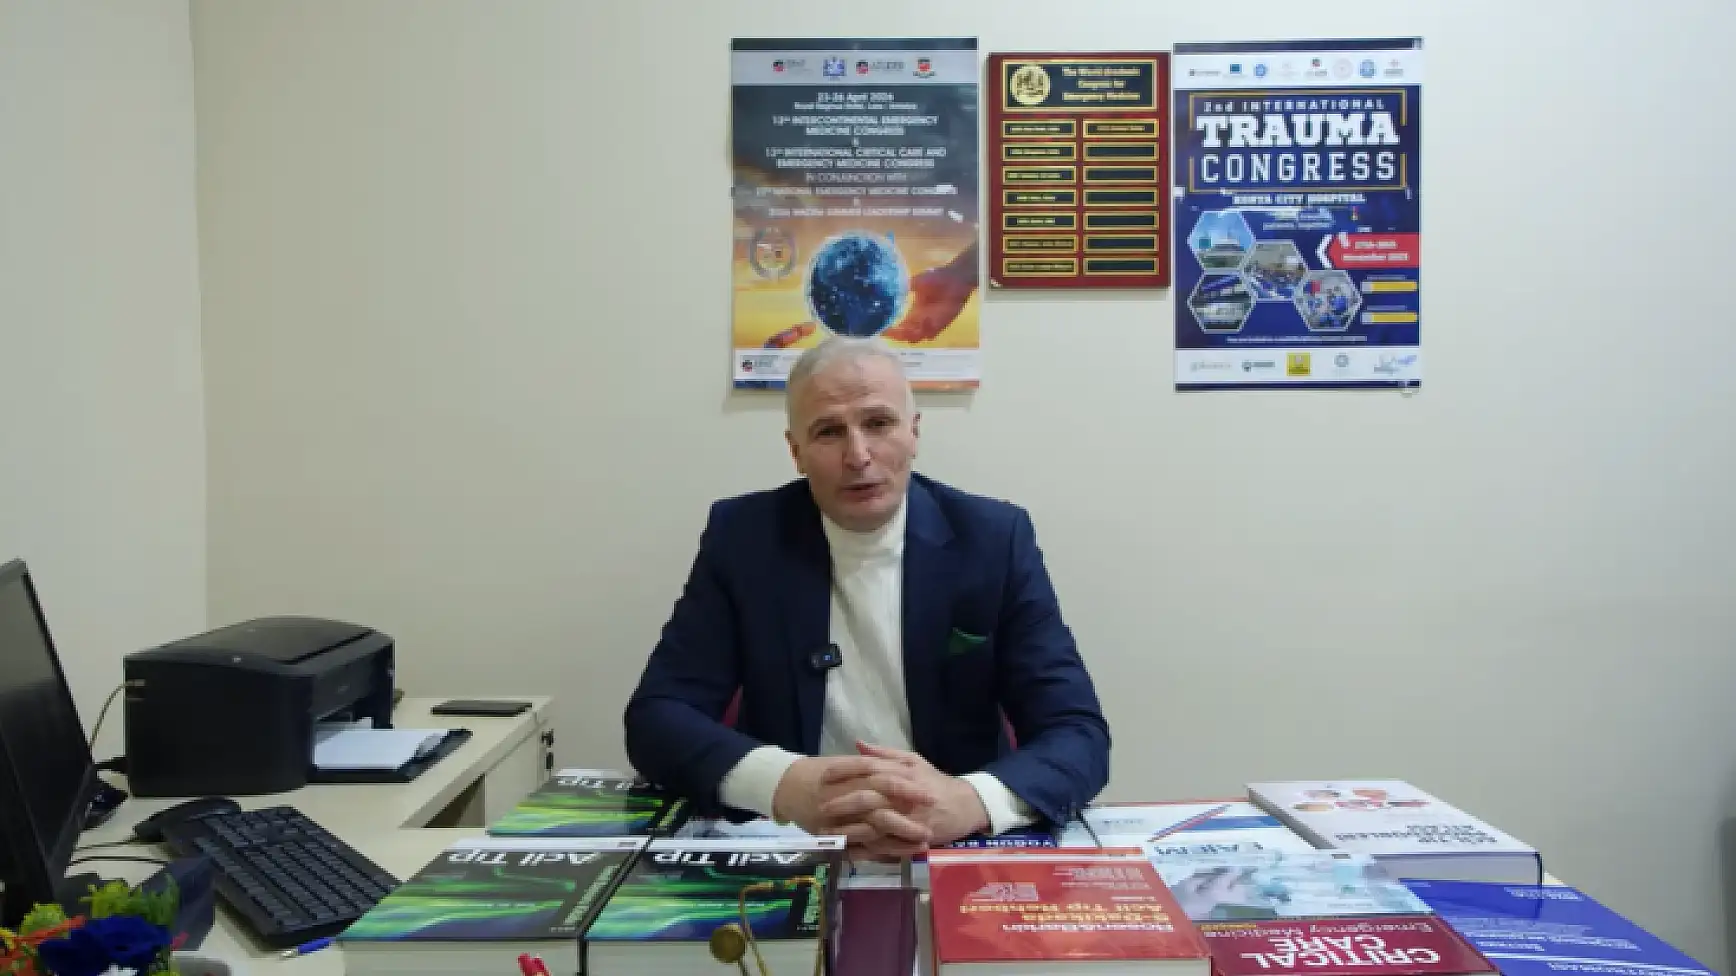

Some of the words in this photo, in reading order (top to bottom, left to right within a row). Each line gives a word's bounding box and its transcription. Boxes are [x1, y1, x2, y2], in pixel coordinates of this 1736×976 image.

[1062, 65, 1077, 76] The
[1078, 65, 1103, 76] World
[846, 92, 868, 104] April
[1062, 92, 1104, 102] Emergency
[1203, 101, 1234, 112] 2nd
[1242, 98, 1385, 112] INTERNATIONAL
[806, 126, 851, 136] MEDICINE
[853, 126, 905, 136] CONGRESS
[1196, 112, 1400, 148] TRAUMA
[776, 158, 835, 169] EMERGENCY
[836, 158, 882, 169] MEDICINE
[883, 158, 936, 169] CONGRESS
[1202, 151, 1395, 183] CONGRESS
[1233, 193, 1272, 206] KONYA
[1275, 193, 1305, 206] CITY
[1307, 191, 1368, 205] HOSPITAL
[517, 851, 603, 866] Acil
[726, 852, 804, 866] Acil
[1203, 926, 1304, 939] Medicine
[1308, 921, 1435, 934] Emergency
[1267, 935, 1388, 955] CARE
[1238, 948, 1442, 970] CRITICAL
